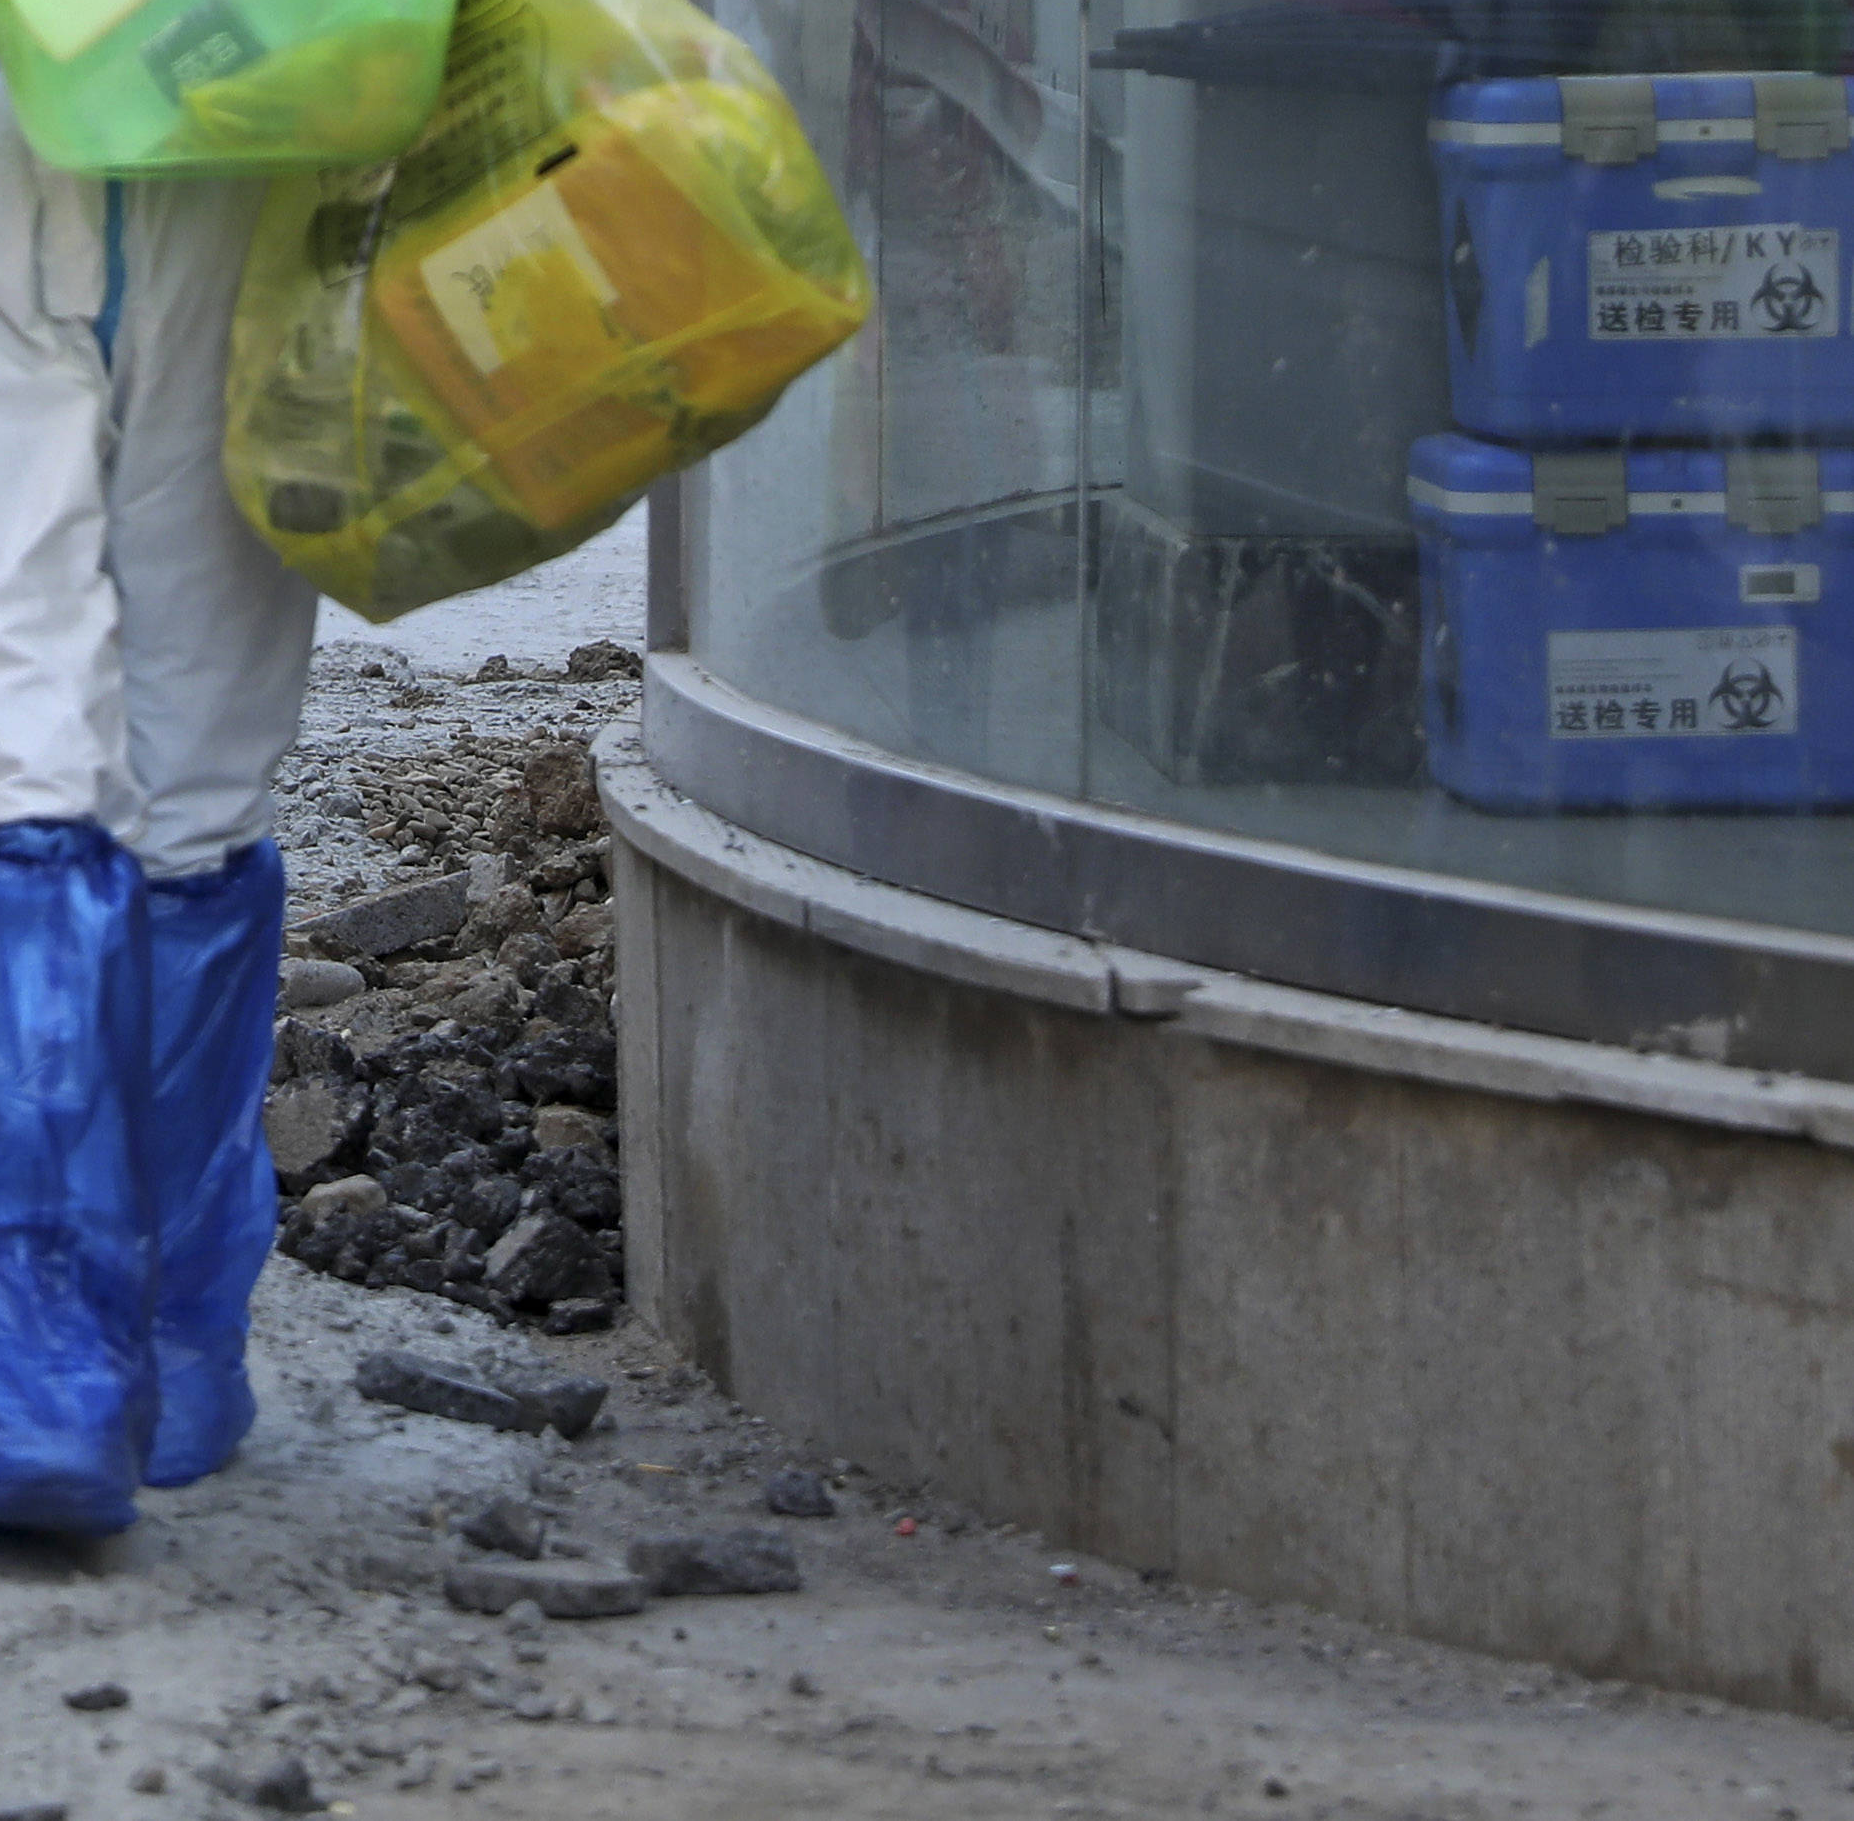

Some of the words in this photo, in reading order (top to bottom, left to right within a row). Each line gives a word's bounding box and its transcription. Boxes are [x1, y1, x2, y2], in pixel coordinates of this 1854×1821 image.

[1597, 300, 1739, 331] 送检专用
[1557, 698, 1698, 730] 送检专用
